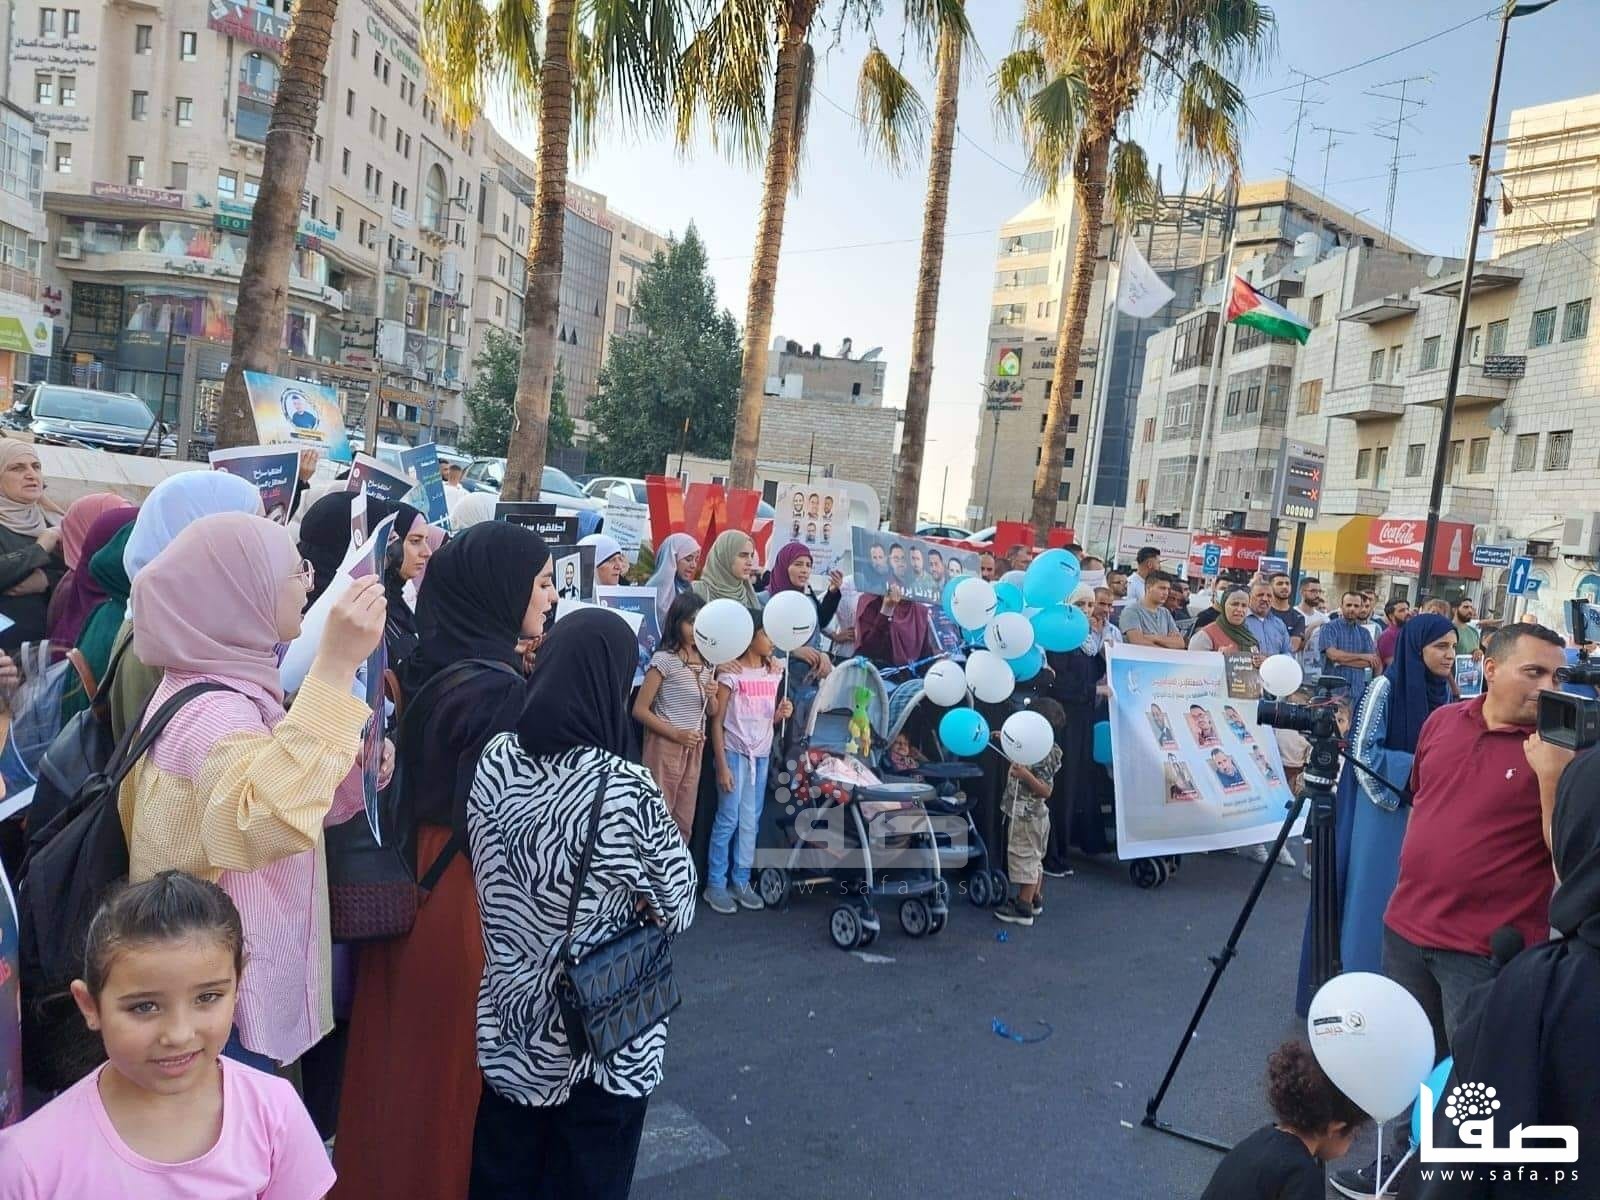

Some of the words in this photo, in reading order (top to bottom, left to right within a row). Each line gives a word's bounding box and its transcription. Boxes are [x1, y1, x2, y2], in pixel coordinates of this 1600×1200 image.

[367, 16, 388, 50] City
[389, 38, 420, 79] Center
[537, 520, 566, 533] أطلقوا
[1380, 520, 1417, 544] Coca-Cola
[1398, 557, 1419, 568] مطعم
